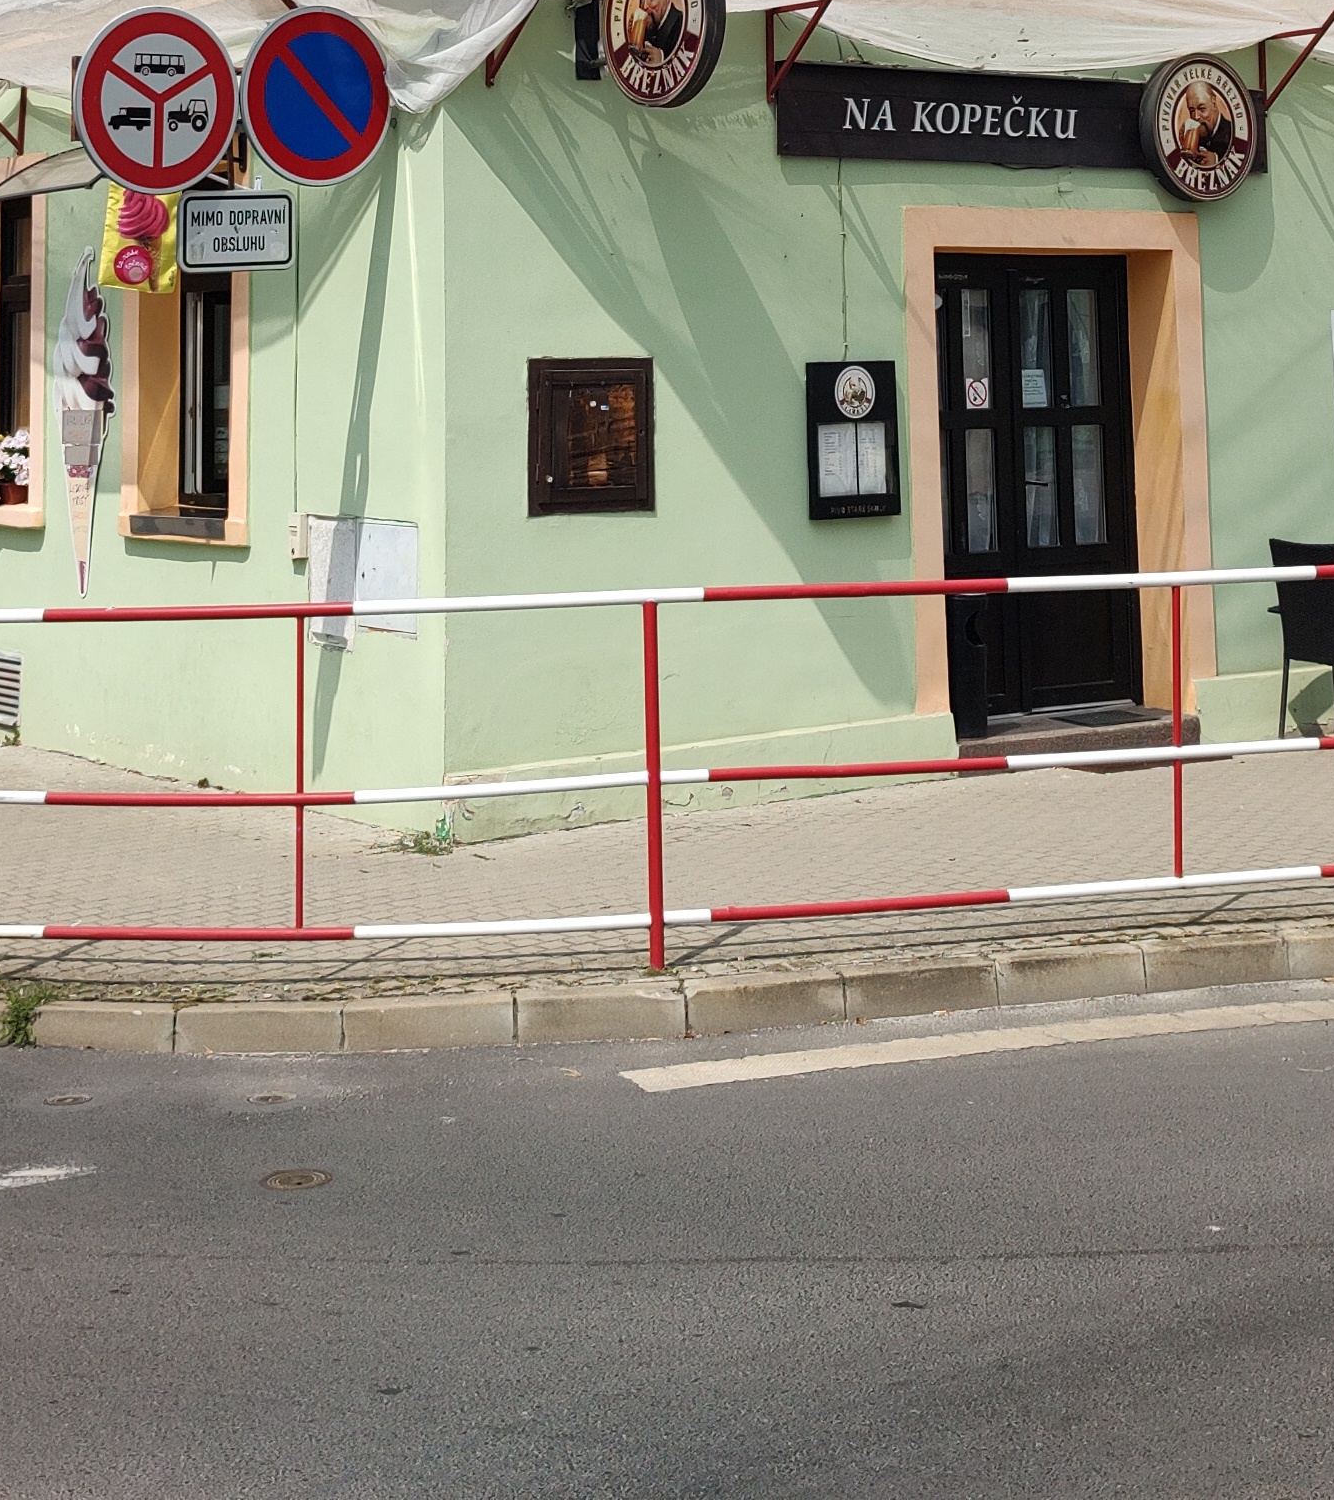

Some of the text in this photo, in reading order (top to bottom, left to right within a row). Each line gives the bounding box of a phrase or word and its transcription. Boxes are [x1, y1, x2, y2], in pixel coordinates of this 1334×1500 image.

[1161, 80, 1182, 132] PIVOVAR
[1183, 67, 1213, 82] VELKÉ
[842, 94, 1079, 140] NA KOPEČKU
[191, 204, 286, 227] MIMO DOPRAVNÍ
[212, 235, 266, 253] OBSLUHU
